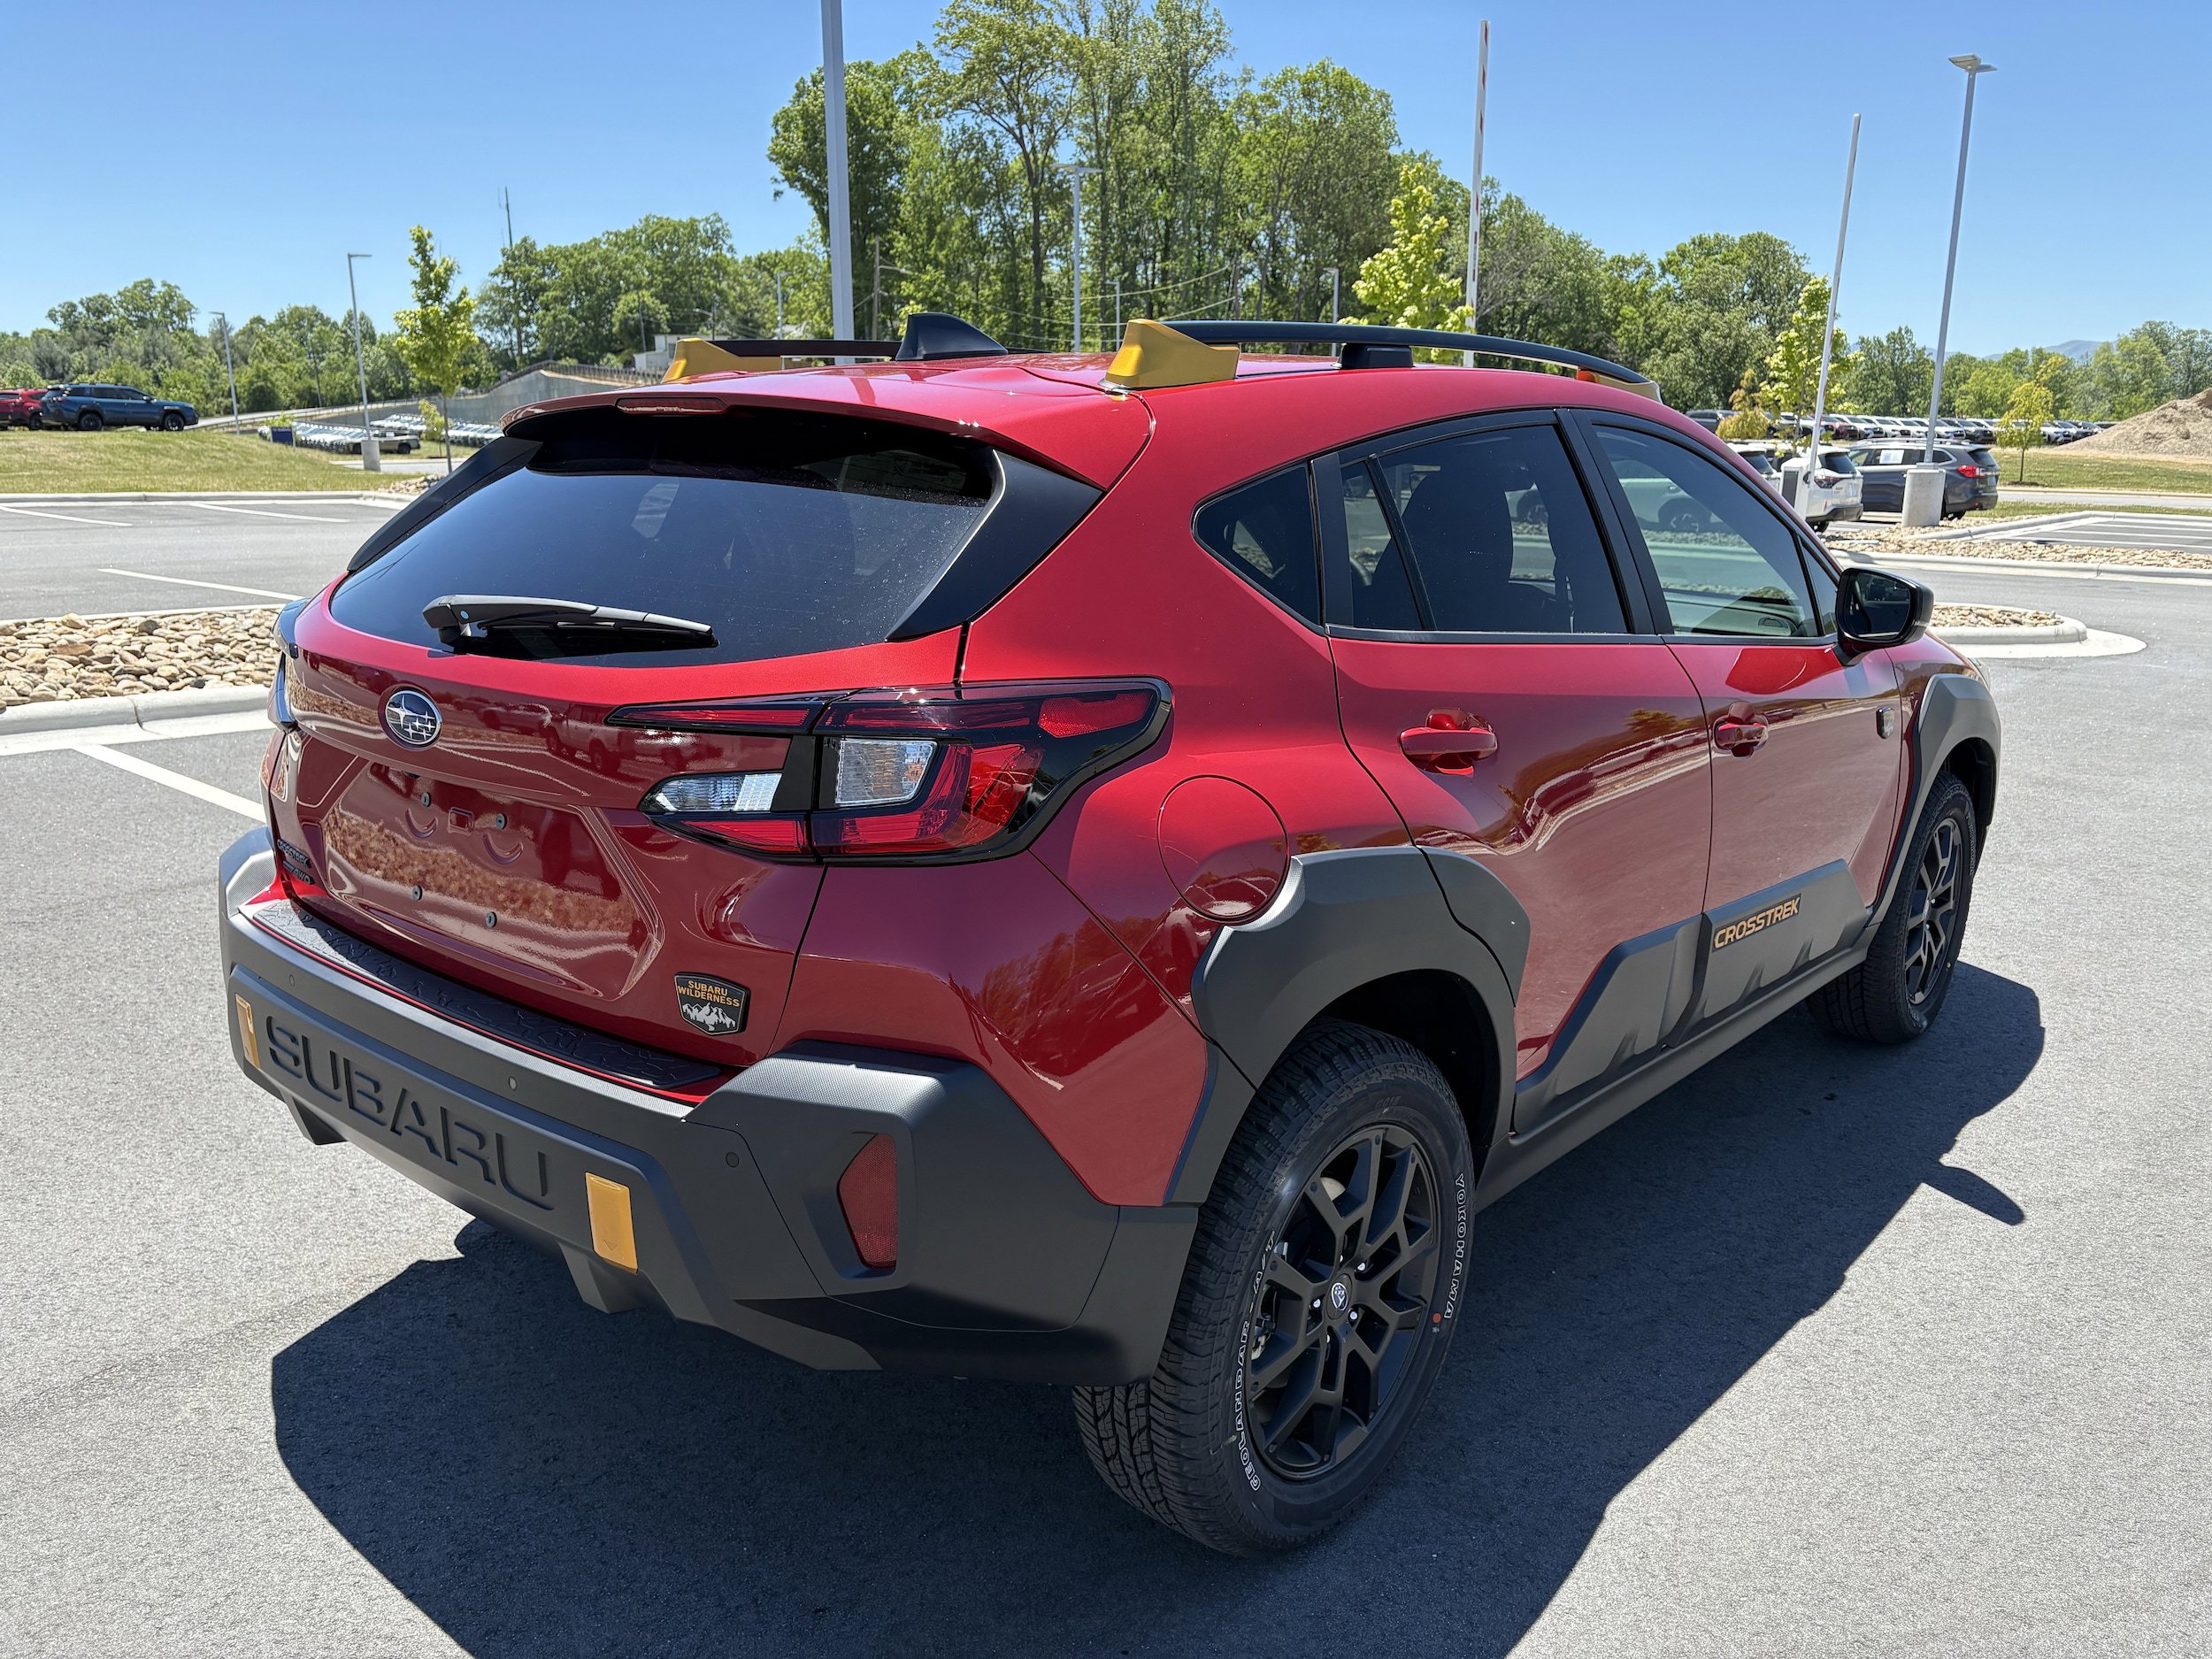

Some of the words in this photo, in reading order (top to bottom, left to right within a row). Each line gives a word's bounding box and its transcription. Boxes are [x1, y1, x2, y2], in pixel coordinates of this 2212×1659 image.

[1715, 897, 1800, 949] CROSSTREK
[678, 986, 741, 1007] WILDERNESS
[688, 980, 728, 996] SUBARU
[266, 1016, 555, 1211] SUBARU
[1444, 1173, 1467, 1318] YOKOHAMA
[1234, 1320, 1261, 1492] GEOLANDAR
